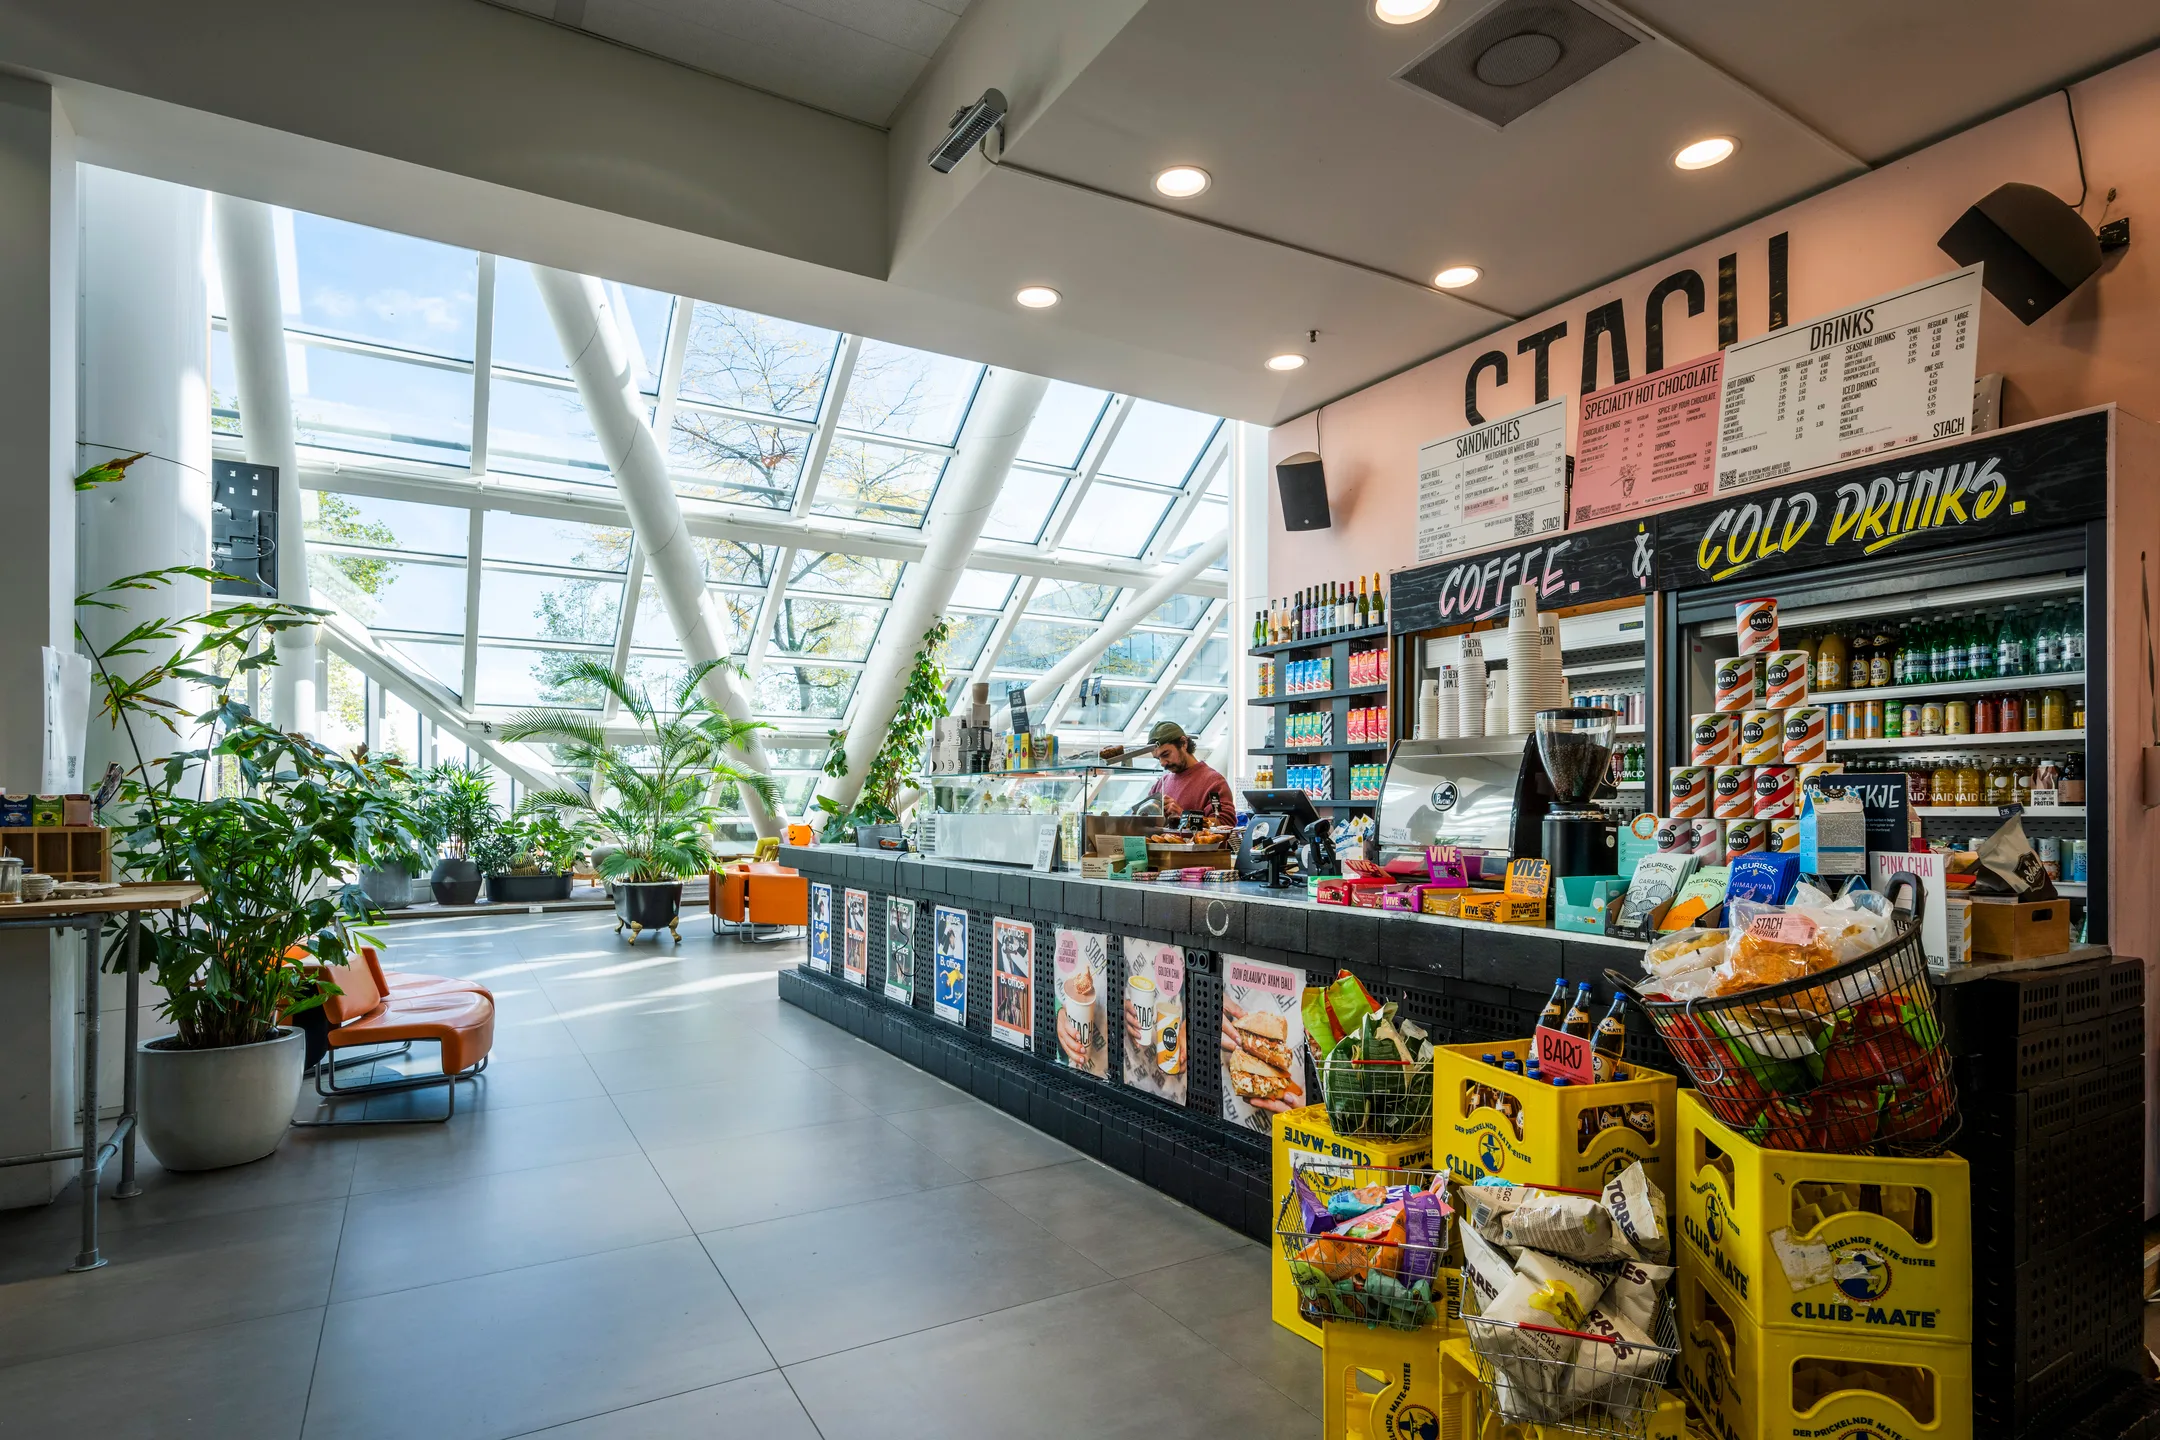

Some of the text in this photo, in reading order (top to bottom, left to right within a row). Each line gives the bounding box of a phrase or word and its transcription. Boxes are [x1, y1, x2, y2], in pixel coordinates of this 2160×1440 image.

[1811, 308, 1874, 351] DRINKS
[1907, 311, 1969, 335] SMALL REGULAR LARGE
[1845, 332, 1896, 354] SEASONAL DRINKS
[1924, 364, 1934, 372] ONE
[1727, 374, 1755, 390] HOT DRINKS
[1842, 378, 1878, 395] ICED DRINKS
[1585, 364, 1719, 420] SPECIALTY HOT CHOCOLATE
[1691, 392, 1717, 406] CHOCOLATE
[1583, 420, 1621, 437] CHOCOLATE BLENDS
[1933, 417, 1965, 438] STACH
[1456, 420, 1520, 458] SANDWICHES
[1514, 442, 1525, 452] WHITE
[1526, 438, 1539, 449] BREAD
[1654, 440, 1676, 452] TOPPINGS
[1693, 482, 1709, 494] STACH
[1542, 516, 1560, 530] STACH
[1697, 492, 1816, 572] COLD
[1751, 615, 1773, 626] BARÚ
[1695, 730, 1716, 739] BARÚ
[1729, 834, 1749, 844] BARÚ
[1429, 846, 1457, 863] VIVE
[1349, 860, 1373, 872] VIVE
[1513, 859, 1545, 877] VIVE
[1639, 862, 1677, 873] MEURISSE
[1734, 862, 1778, 875] MEURISSE
[1880, 855, 1933, 877] PINK CHAI
[1688, 878, 1727, 888] MEURISSE
[1732, 882, 1772, 890] HIMALAYAN
[1319, 890, 1331, 900] VIVE
[1385, 896, 1399, 905] VIVE
[1465, 905, 1479, 915] VIVE
[1511, 902, 1541, 910] NAUGHTY
[945, 913, 960, 924] office
[1756, 918, 1783, 929] STACH
[1000, 924, 1025, 939] A. office
[1750, 928, 1779, 939] PAPRIKA
[940, 956, 961, 972] B. office
[1927, 955, 1944, 966] STACH
[1157, 966, 1171, 978] GOLDEN
[1232, 967, 1293, 991] RON BLAAUW'S AYAM BALI
[1000, 974, 1025, 990] B. office
[1025, 1038, 1031, 1048] B.
[1454, 1123, 1465, 1134] DER
[1466, 1122, 1497, 1134] PRICKELNDE
[1606, 1179, 1641, 1247] TORRES
[1684, 1214, 1749, 1301] CLUB-MATE
[1873, 1240, 1936, 1268] MATE-EISTEE
[1447, 1277, 1460, 1321] CLUB-MATE
[1790, 1302, 1936, 1329] CLUB-MATE
[1389, 1362, 1412, 1413] MATE-EISTEE
[1792, 1417, 1874, 1438] DER PRICKELNDE
